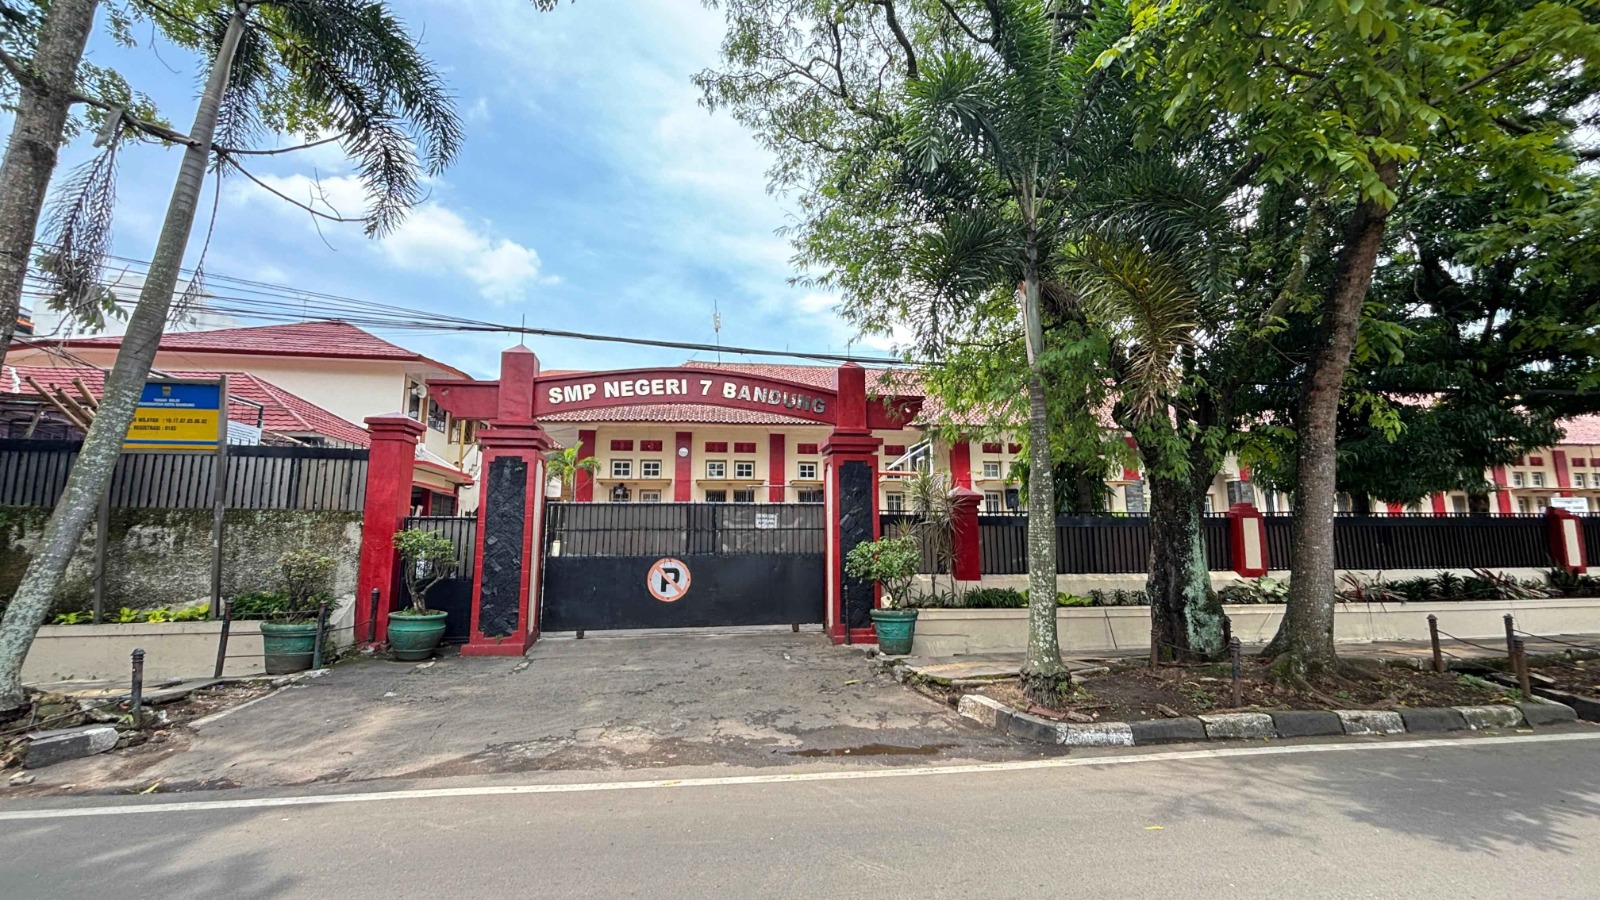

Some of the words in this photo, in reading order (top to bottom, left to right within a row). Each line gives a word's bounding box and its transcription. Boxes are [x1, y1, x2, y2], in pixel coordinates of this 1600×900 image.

[548, 383, 597, 404] SMP
[604, 378, 688, 398] NEGERI
[699, 380, 713, 396] 7
[722, 382, 826, 414] BANDUNG
